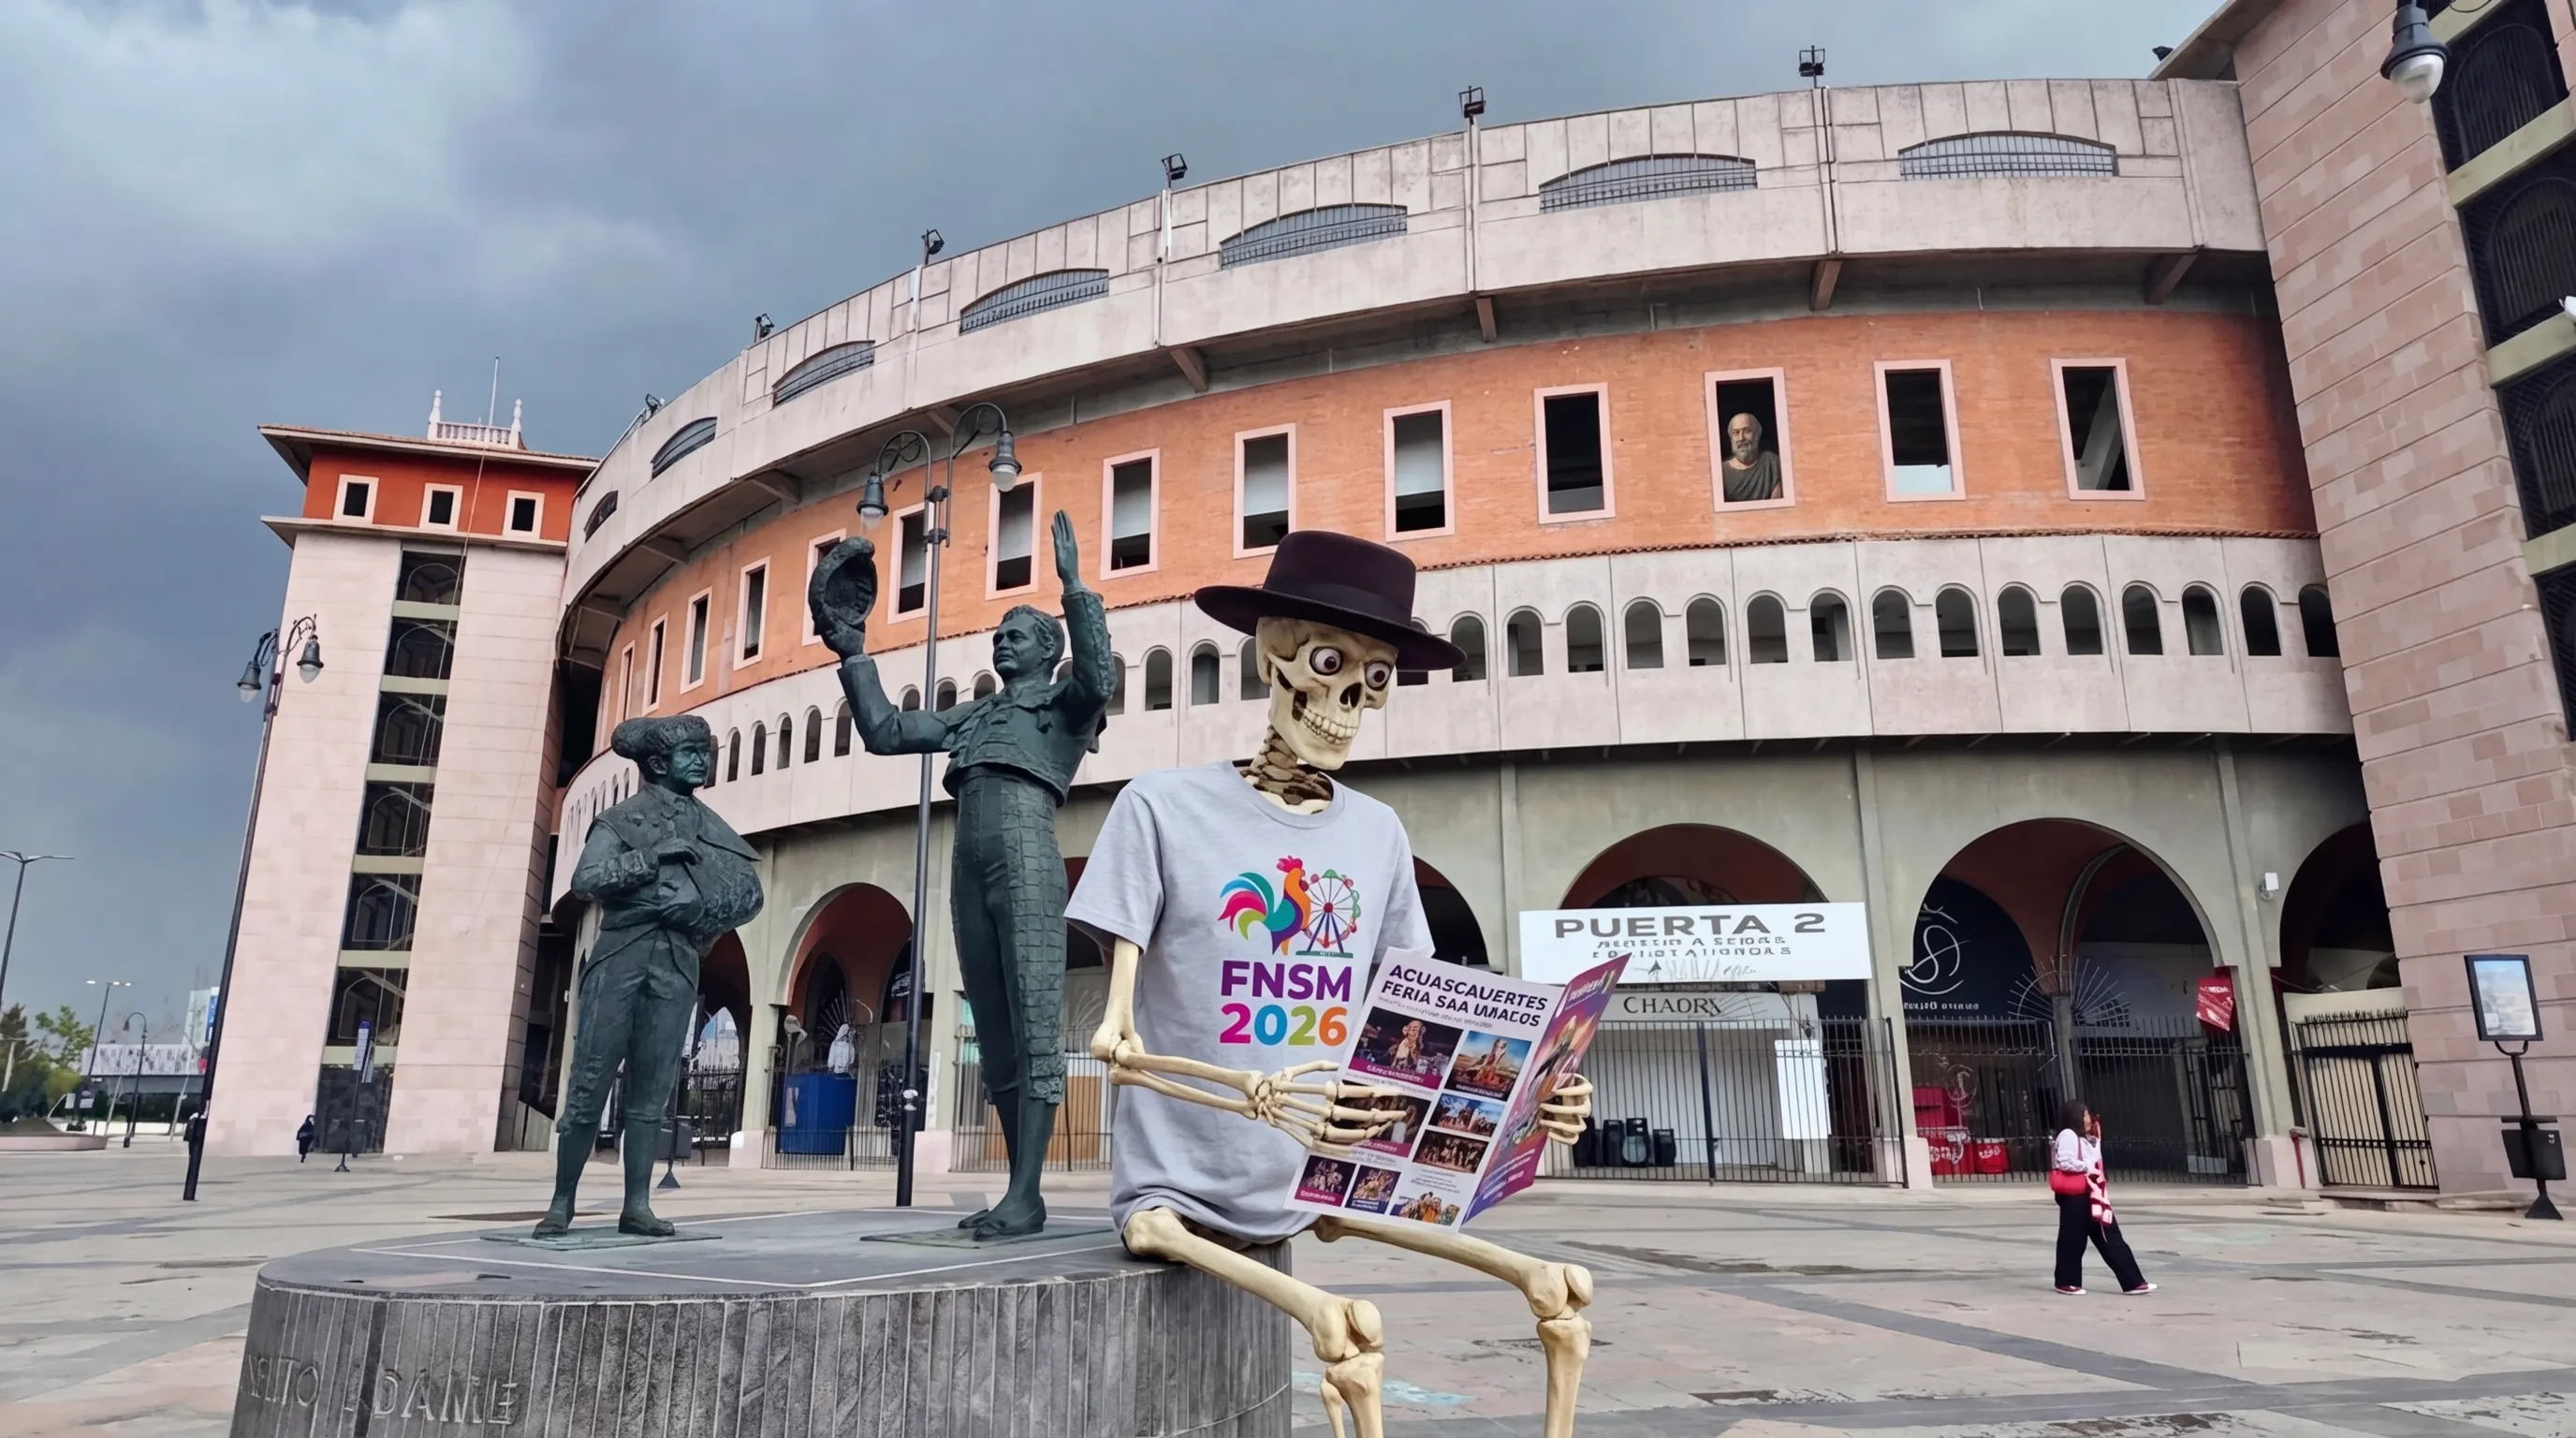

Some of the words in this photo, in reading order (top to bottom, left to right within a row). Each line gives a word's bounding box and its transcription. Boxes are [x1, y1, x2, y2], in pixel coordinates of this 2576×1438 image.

[1555, 915, 1771, 938] PUERTA
[1793, 913, 1825, 933] 2
[1221, 960, 1353, 1002] FNSM
[1381, 980, 1431, 1005] FERIA
[1220, 1003, 1348, 1047] 2026
